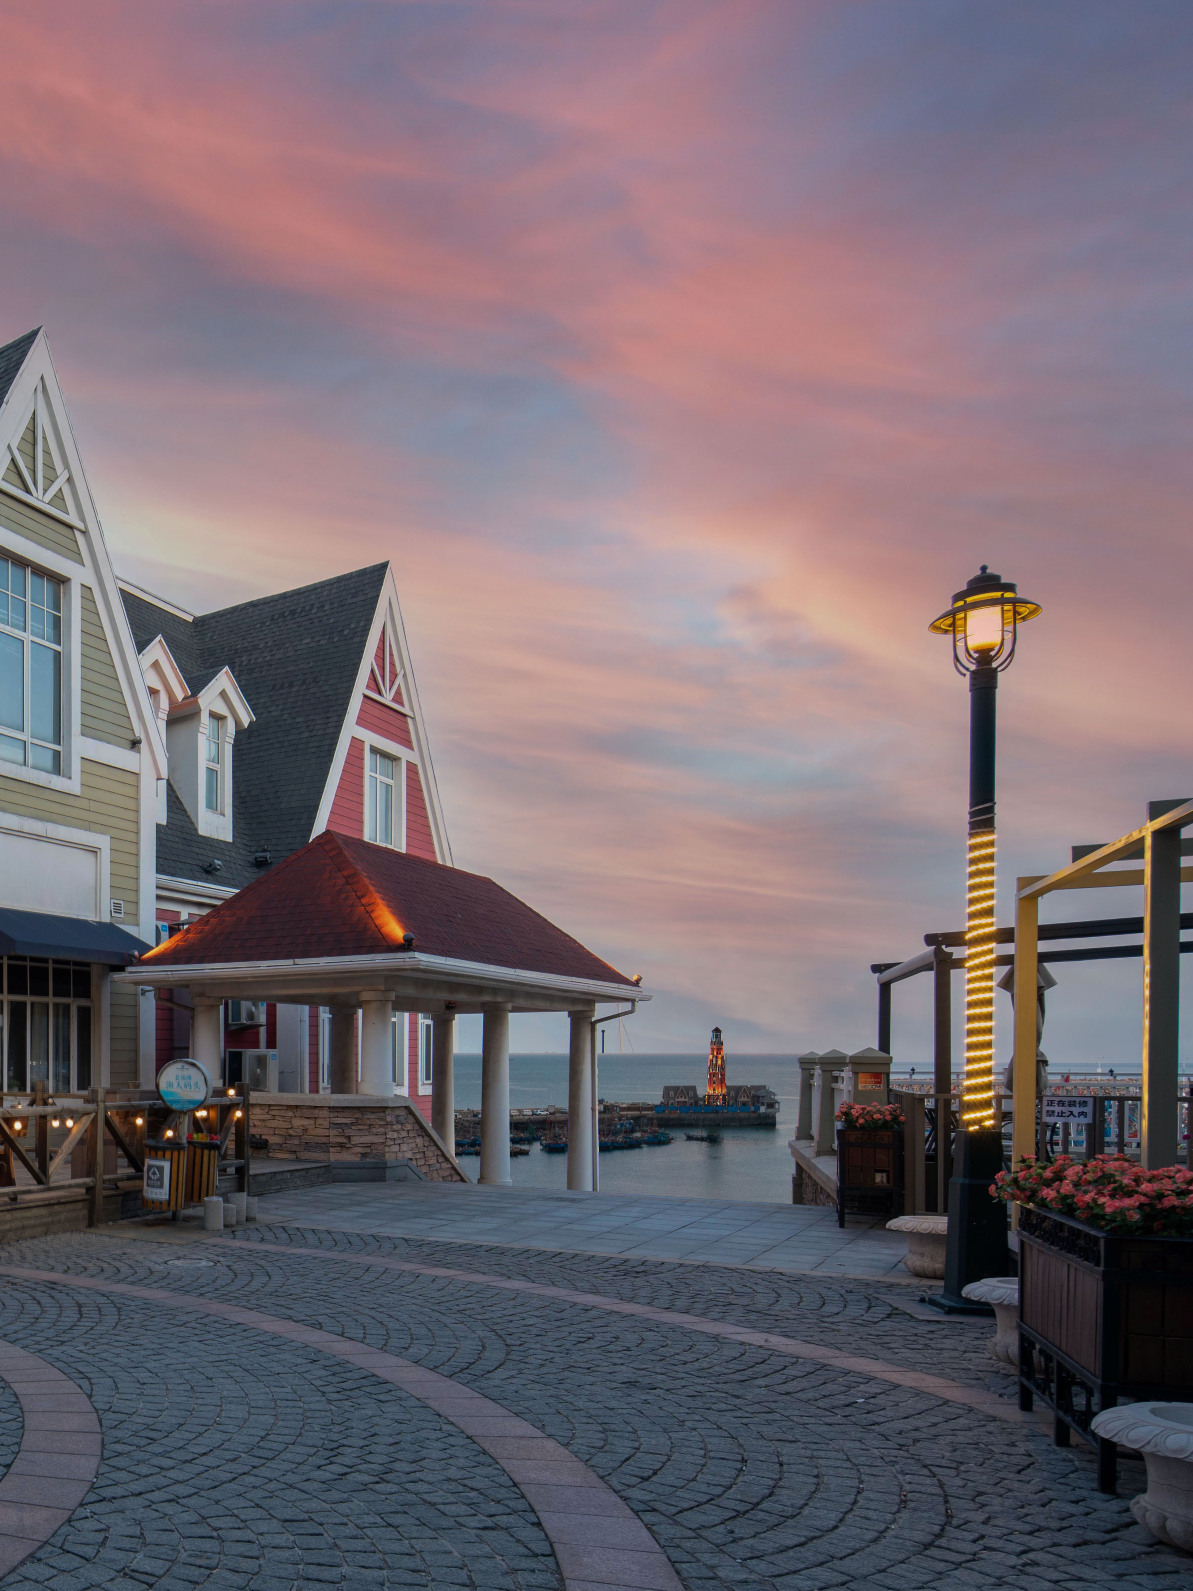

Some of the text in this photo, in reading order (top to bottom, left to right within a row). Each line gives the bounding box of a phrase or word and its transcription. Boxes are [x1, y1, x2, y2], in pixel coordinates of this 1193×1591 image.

[166, 1080, 201, 1091] 渔人码头
[1045, 1110, 1088, 1119] 禁止入内
